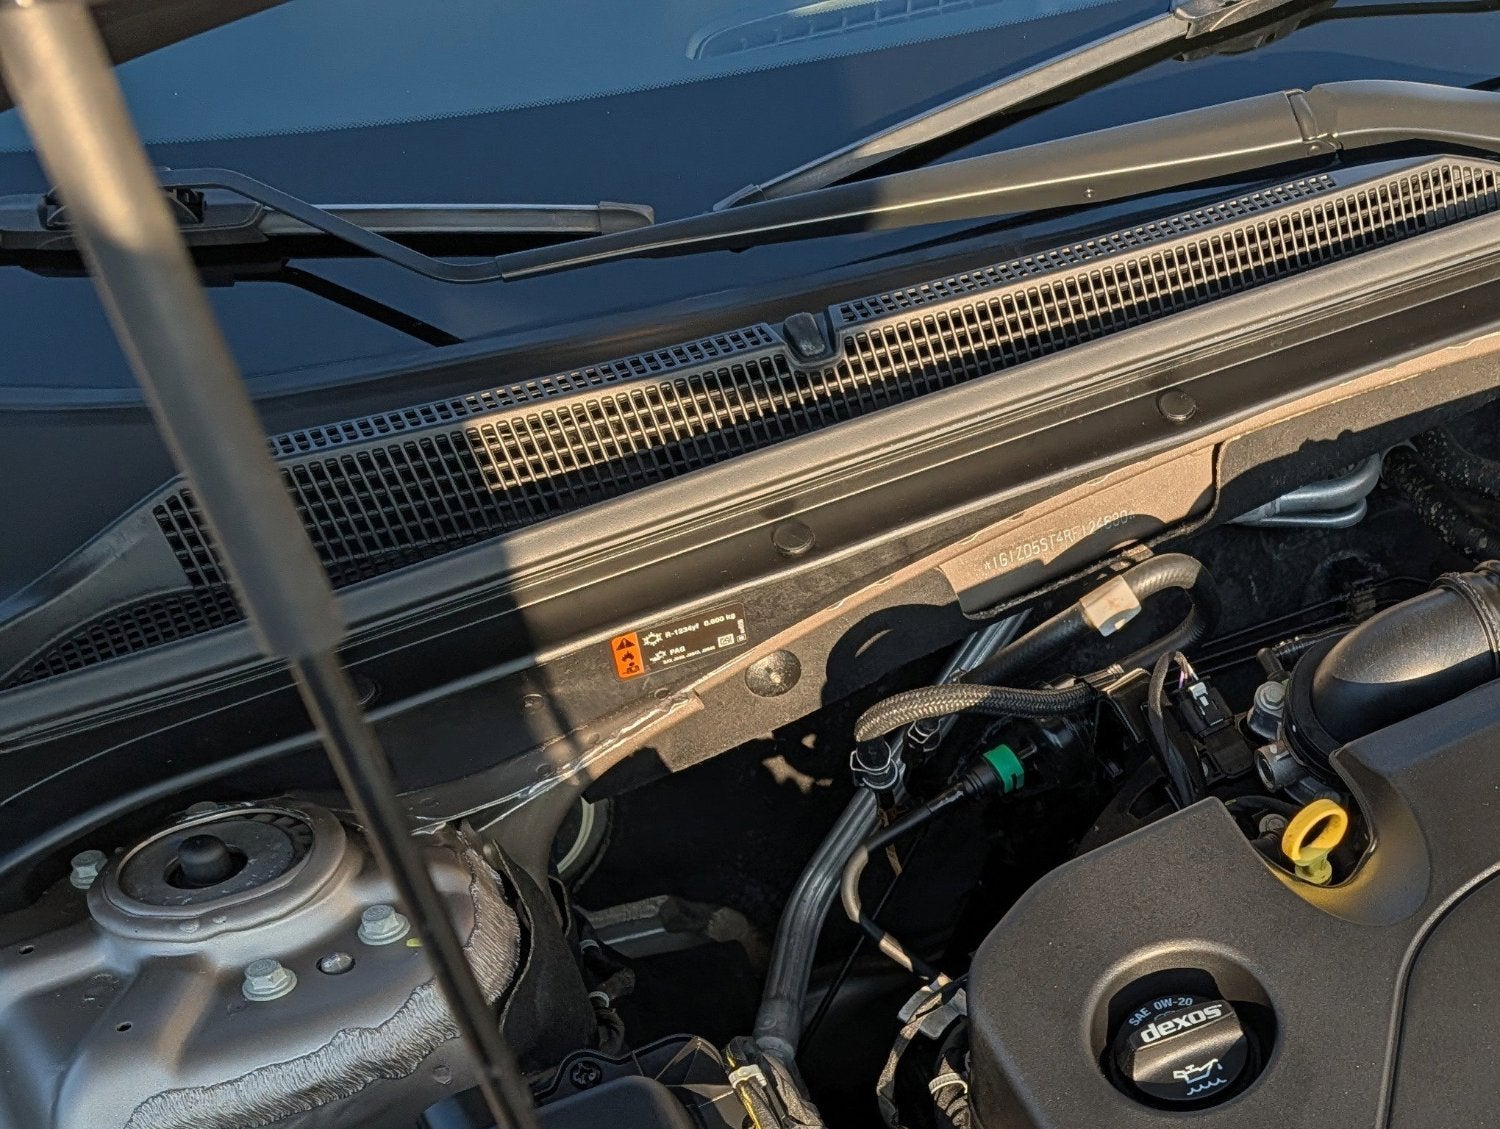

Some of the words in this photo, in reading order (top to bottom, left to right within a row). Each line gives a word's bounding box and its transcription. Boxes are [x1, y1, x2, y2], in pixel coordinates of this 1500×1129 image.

[664, 622, 700, 639] R-1234yf
[725, 612, 736, 622] kg
[669, 645, 686, 656] PAG
[1128, 1006, 1151, 1027] SAE
[1154, 997, 1193, 1011] 0W-20
[1140, 1004, 1222, 1043] dexos
